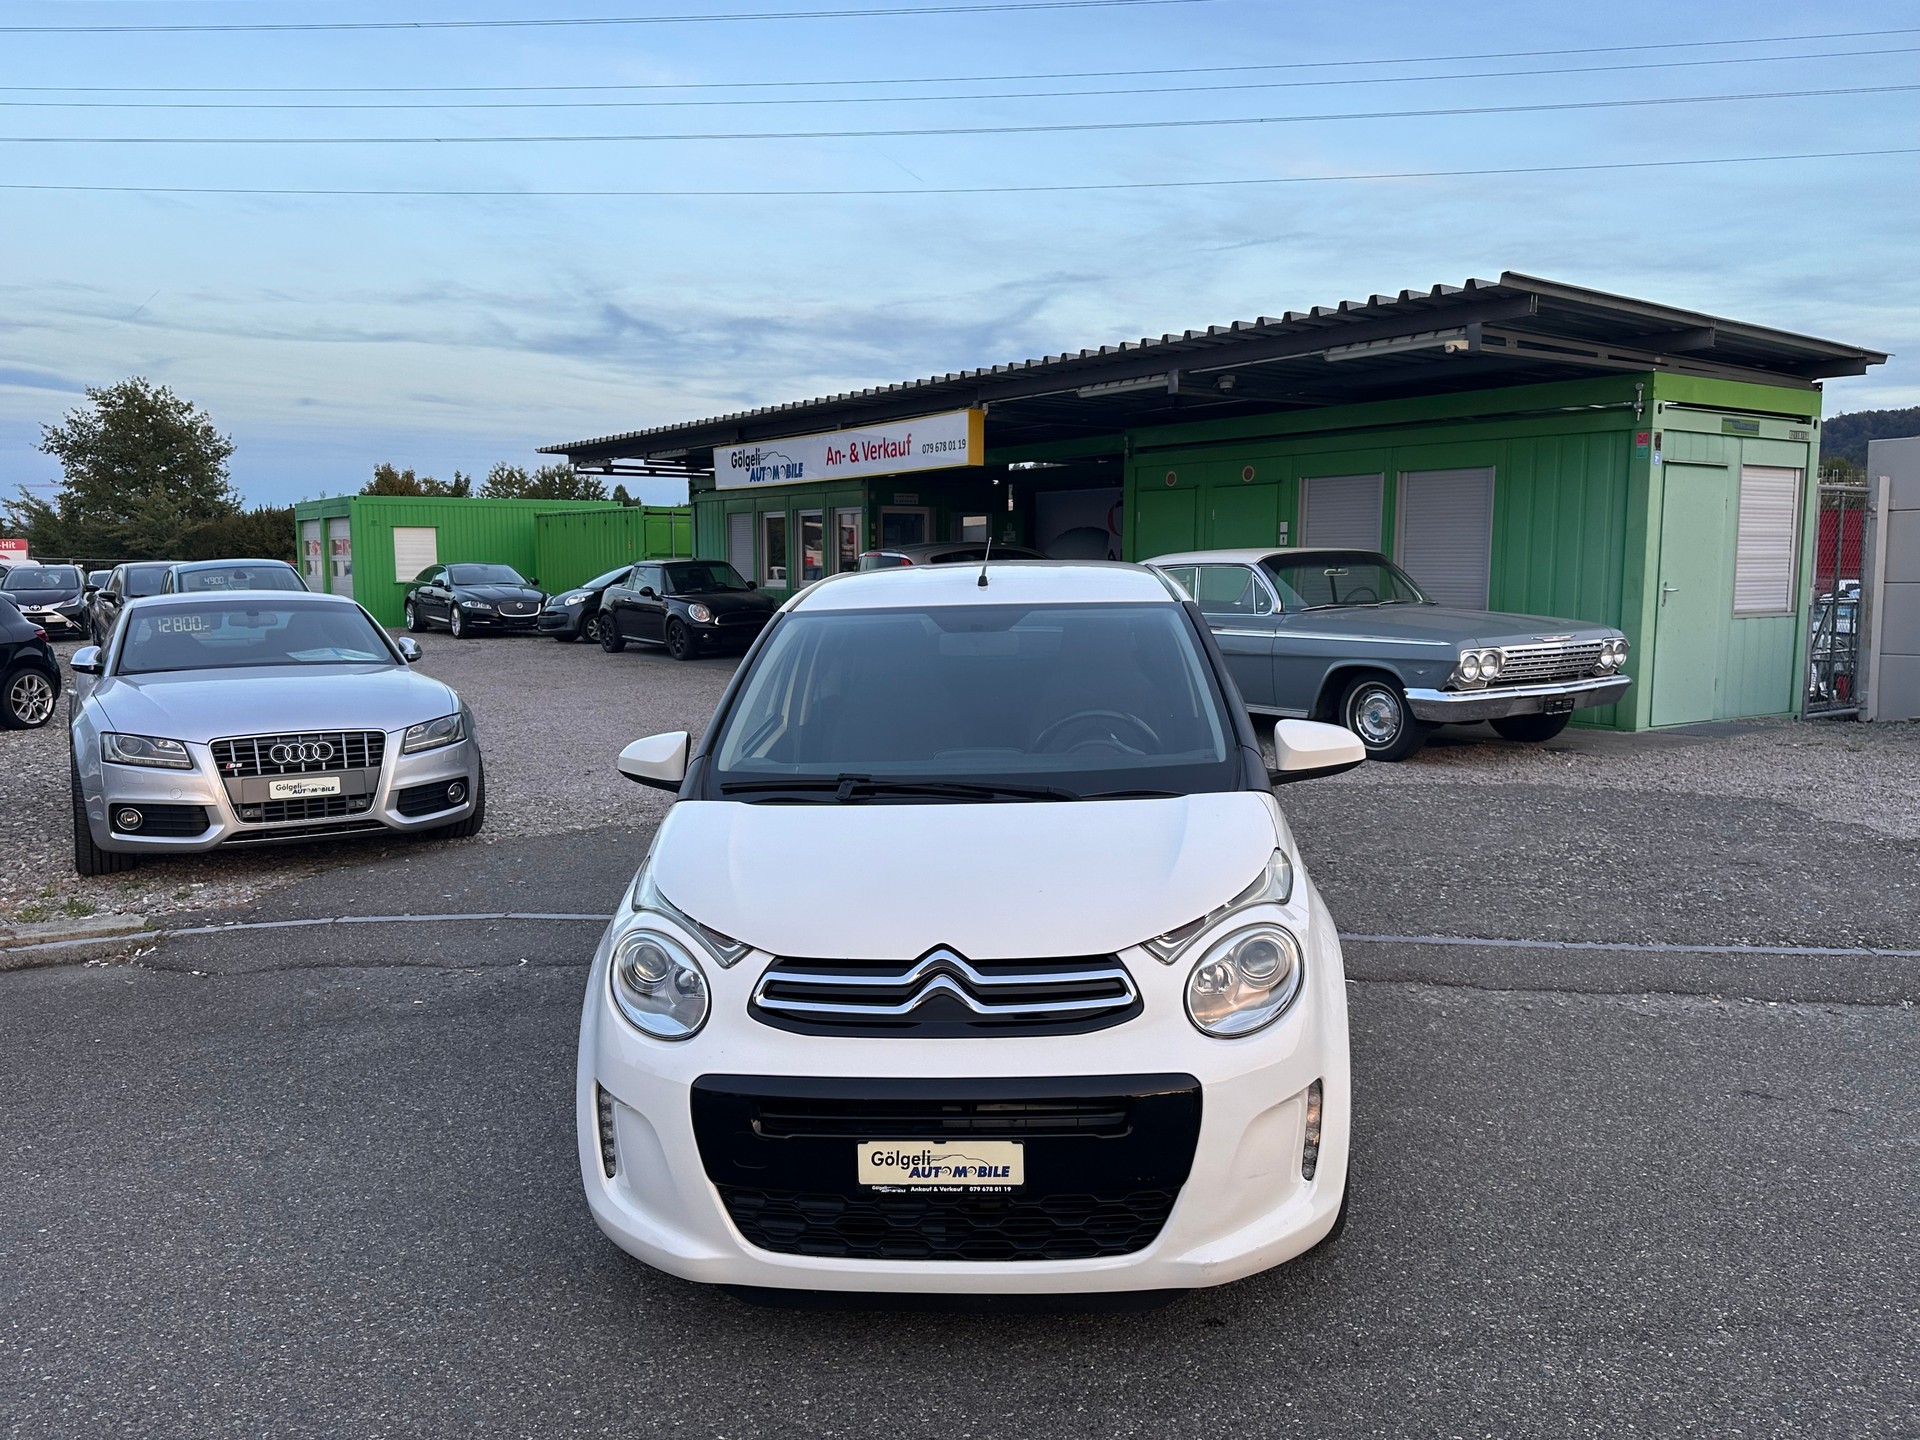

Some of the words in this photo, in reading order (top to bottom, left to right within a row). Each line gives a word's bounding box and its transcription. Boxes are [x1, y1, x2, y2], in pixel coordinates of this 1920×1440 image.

[826, 446, 846, 466] An-
[849, 442, 860, 463] &
[861, 433, 912, 461] Verkauf
[921, 443, 935, 454] 079
[936, 441, 948, 453] 678
[948, 440, 957, 452] 01
[958, 438, 967, 450] 19
[730, 448, 761, 472] Gölgeli
[275, 782, 302, 792] Gölgeli
[871, 1150, 931, 1169] Gölgeli
